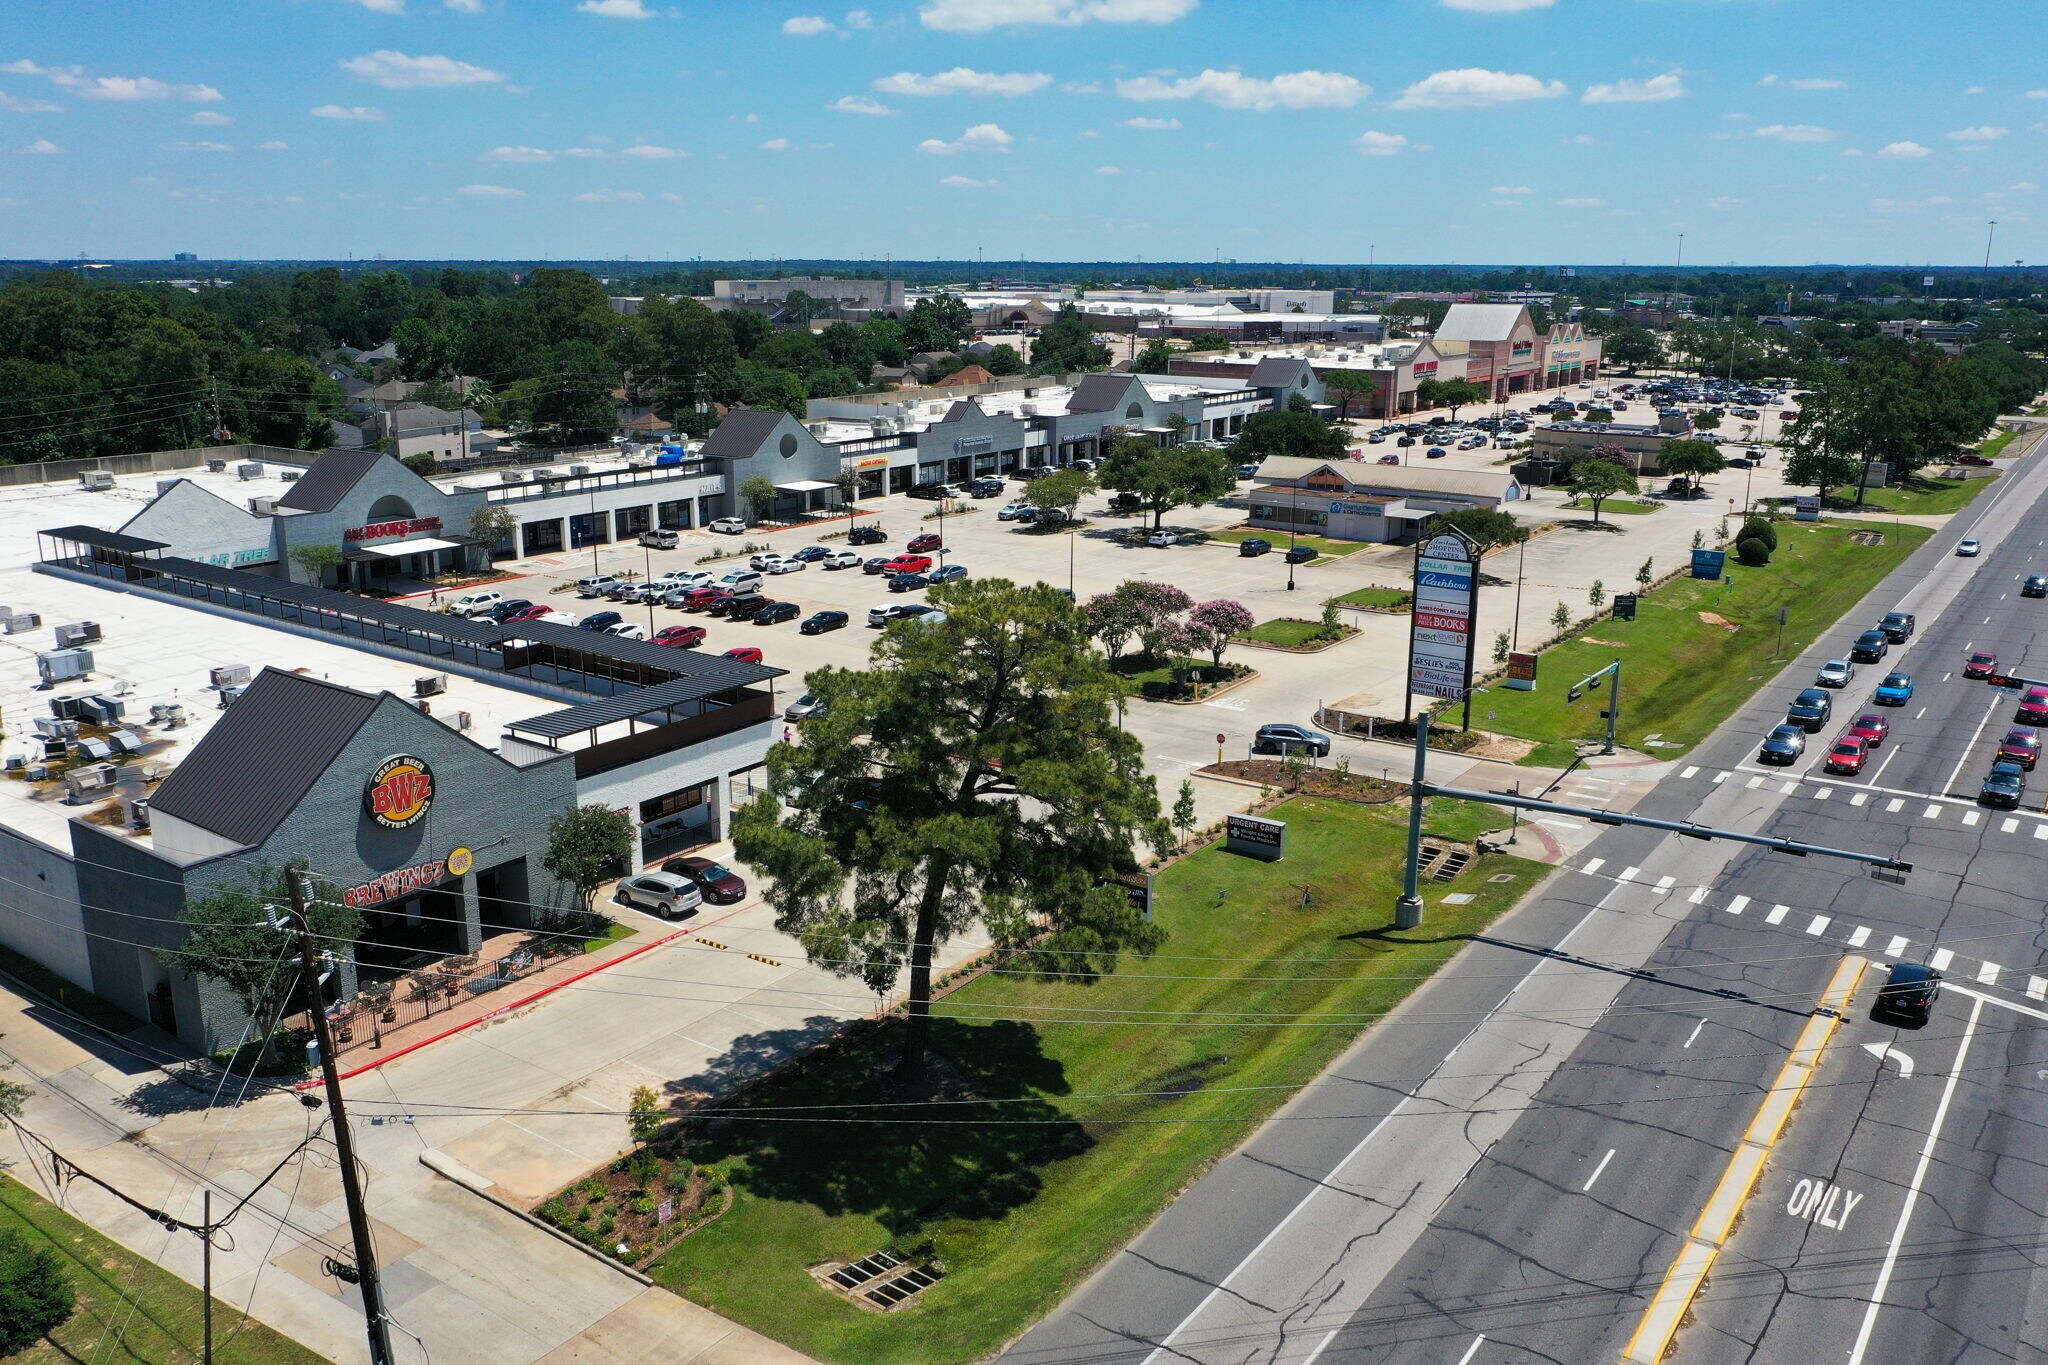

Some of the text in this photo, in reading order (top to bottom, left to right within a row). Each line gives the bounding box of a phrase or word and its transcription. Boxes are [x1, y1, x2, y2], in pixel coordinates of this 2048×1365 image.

[366, 521, 409, 539] BOOKS
[234, 548, 271, 562] TREE
[1428, 544, 1464, 554] SHOPPING
[1432, 551, 1460, 560] CENTER
[1420, 562, 1448, 570] DOLLAR
[1421, 573, 1468, 590] Rainbow
[1434, 617, 1466, 630] BOOKS
[1424, 671, 1450, 682] BioLife
[1435, 686, 1462, 700] NAILS
[374, 758, 425, 783] GREAT BEER
[372, 771, 432, 814] BWZ
[376, 800, 430, 829] BETTER WINGZ
[1229, 818, 1280, 834] URGENT CARE
[343, 860, 446, 908] BREWINGZ
[1787, 1178, 1864, 1230] ONLY
